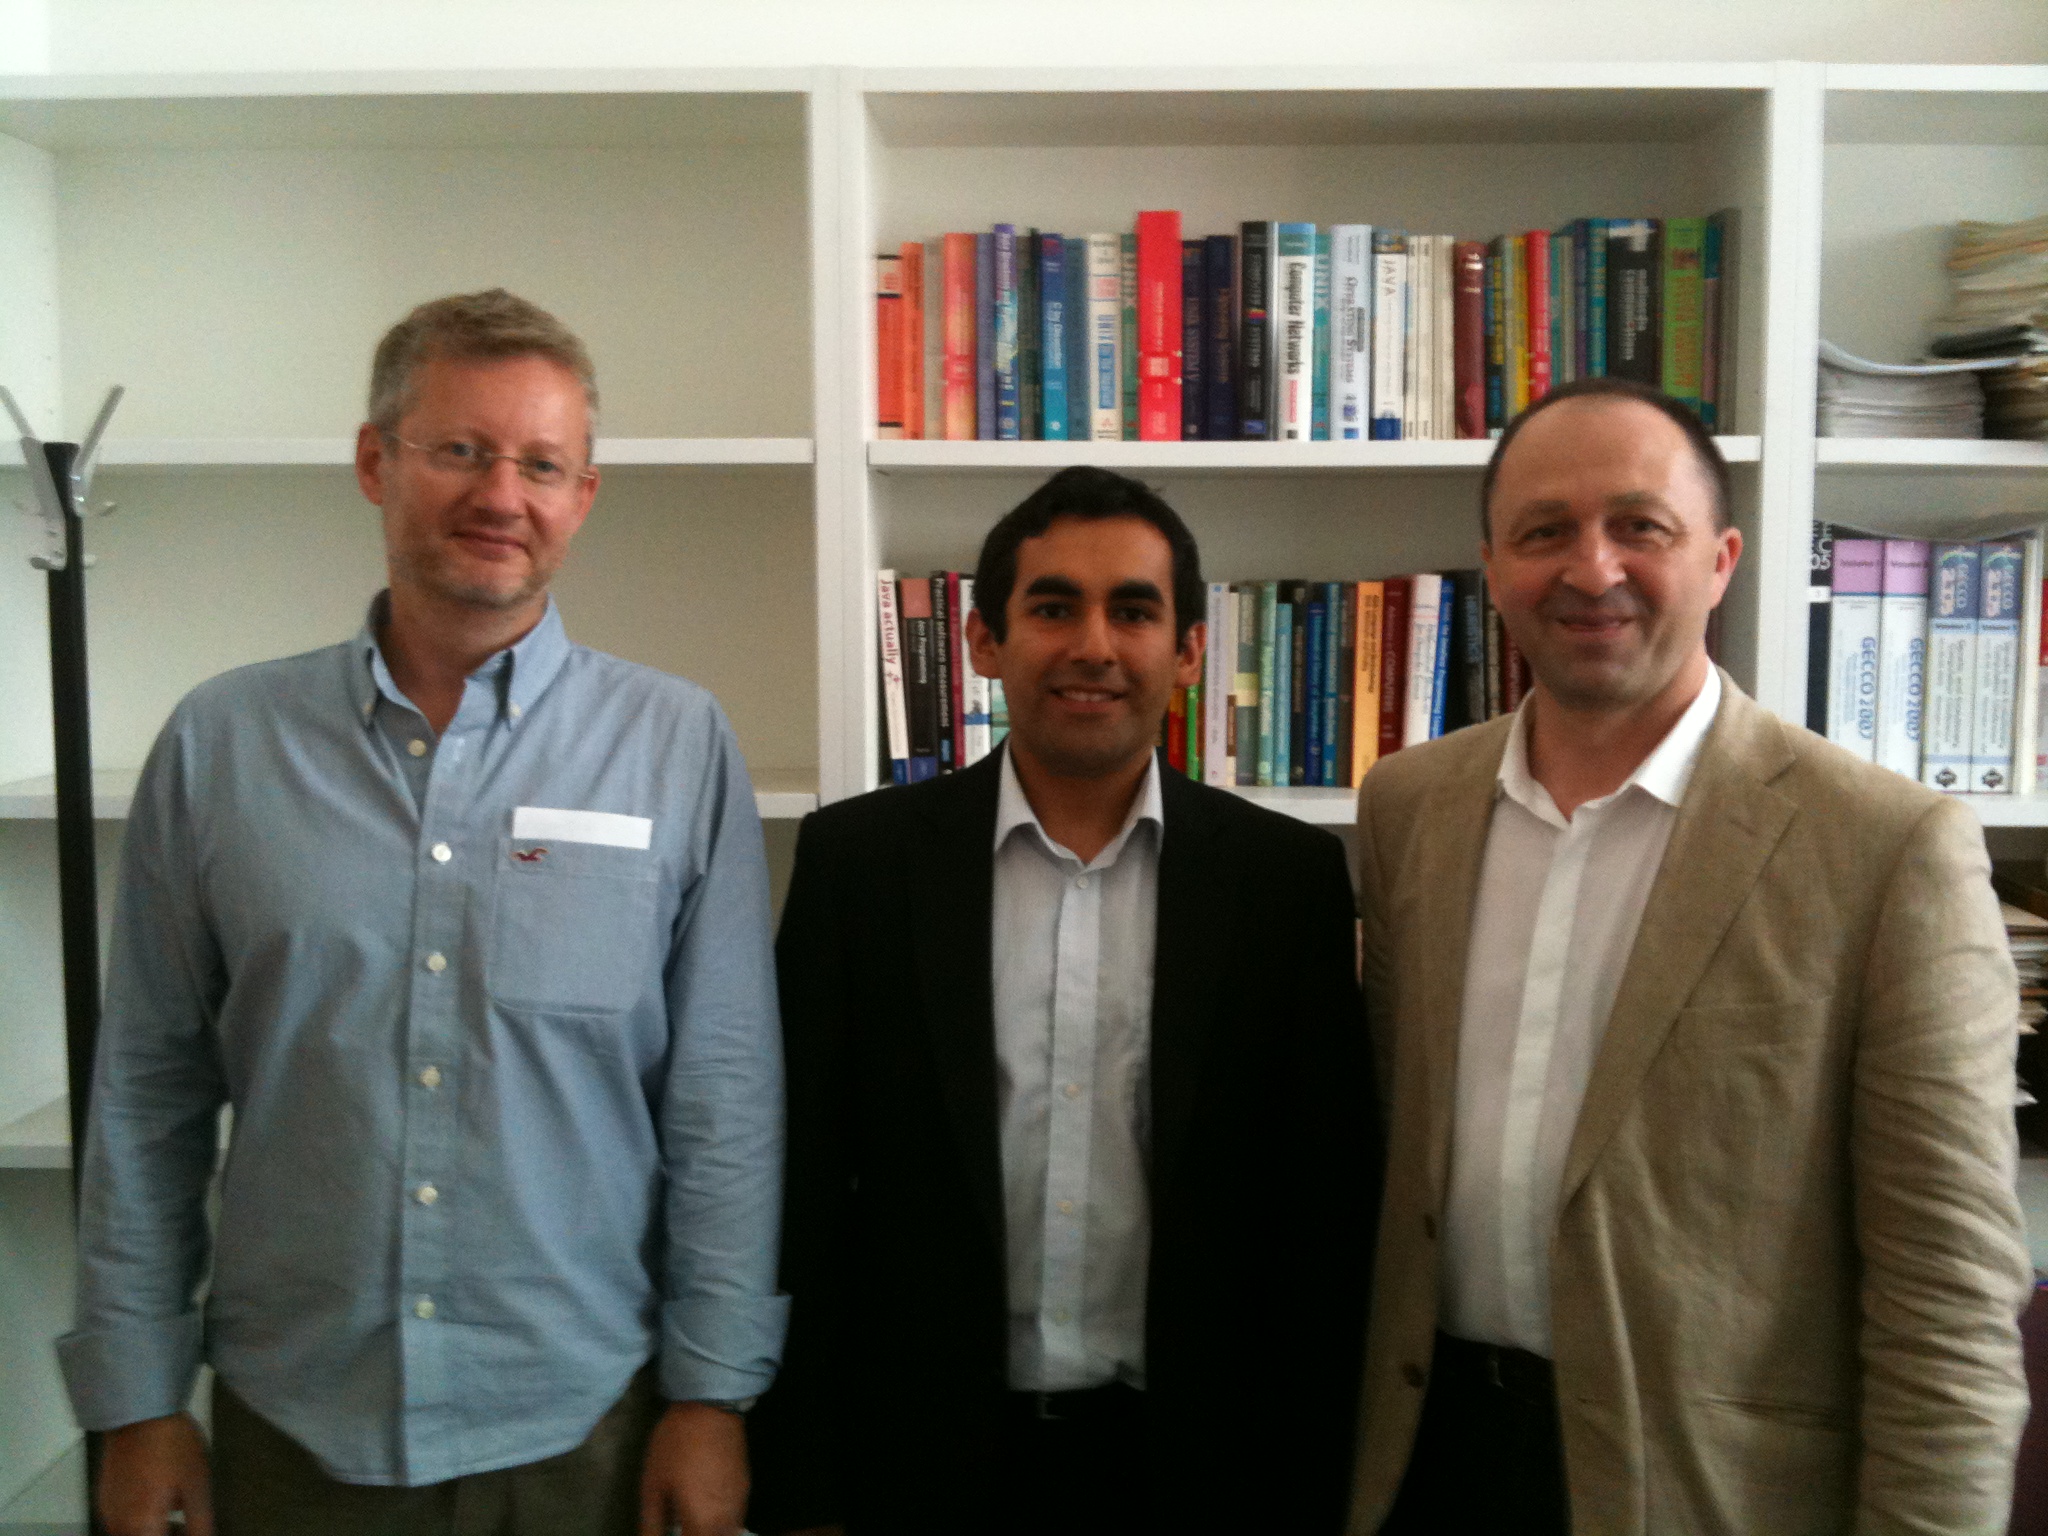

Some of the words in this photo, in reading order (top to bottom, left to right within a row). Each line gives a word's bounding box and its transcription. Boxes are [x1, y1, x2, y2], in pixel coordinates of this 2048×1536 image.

[1285, 263, 1306, 315] Computer
[1384, 259, 1397, 296] JAVA
[1287, 320, 1305, 375] Networks
[880, 579, 895, 608] Java
[935, 578, 946, 619] Practical
[1957, 563, 1969, 608] GECCO
[882, 612, 899, 664] actually
[917, 637, 929, 684] Programming
[937, 621, 948, 662] software
[1861, 636, 1876, 694] GECCO
[1908, 638, 1924, 696] GECCO
[938, 665, 950, 727] measurement
[1860, 698, 1874, 740] 2007
[1907, 700, 1921, 741] 2007
